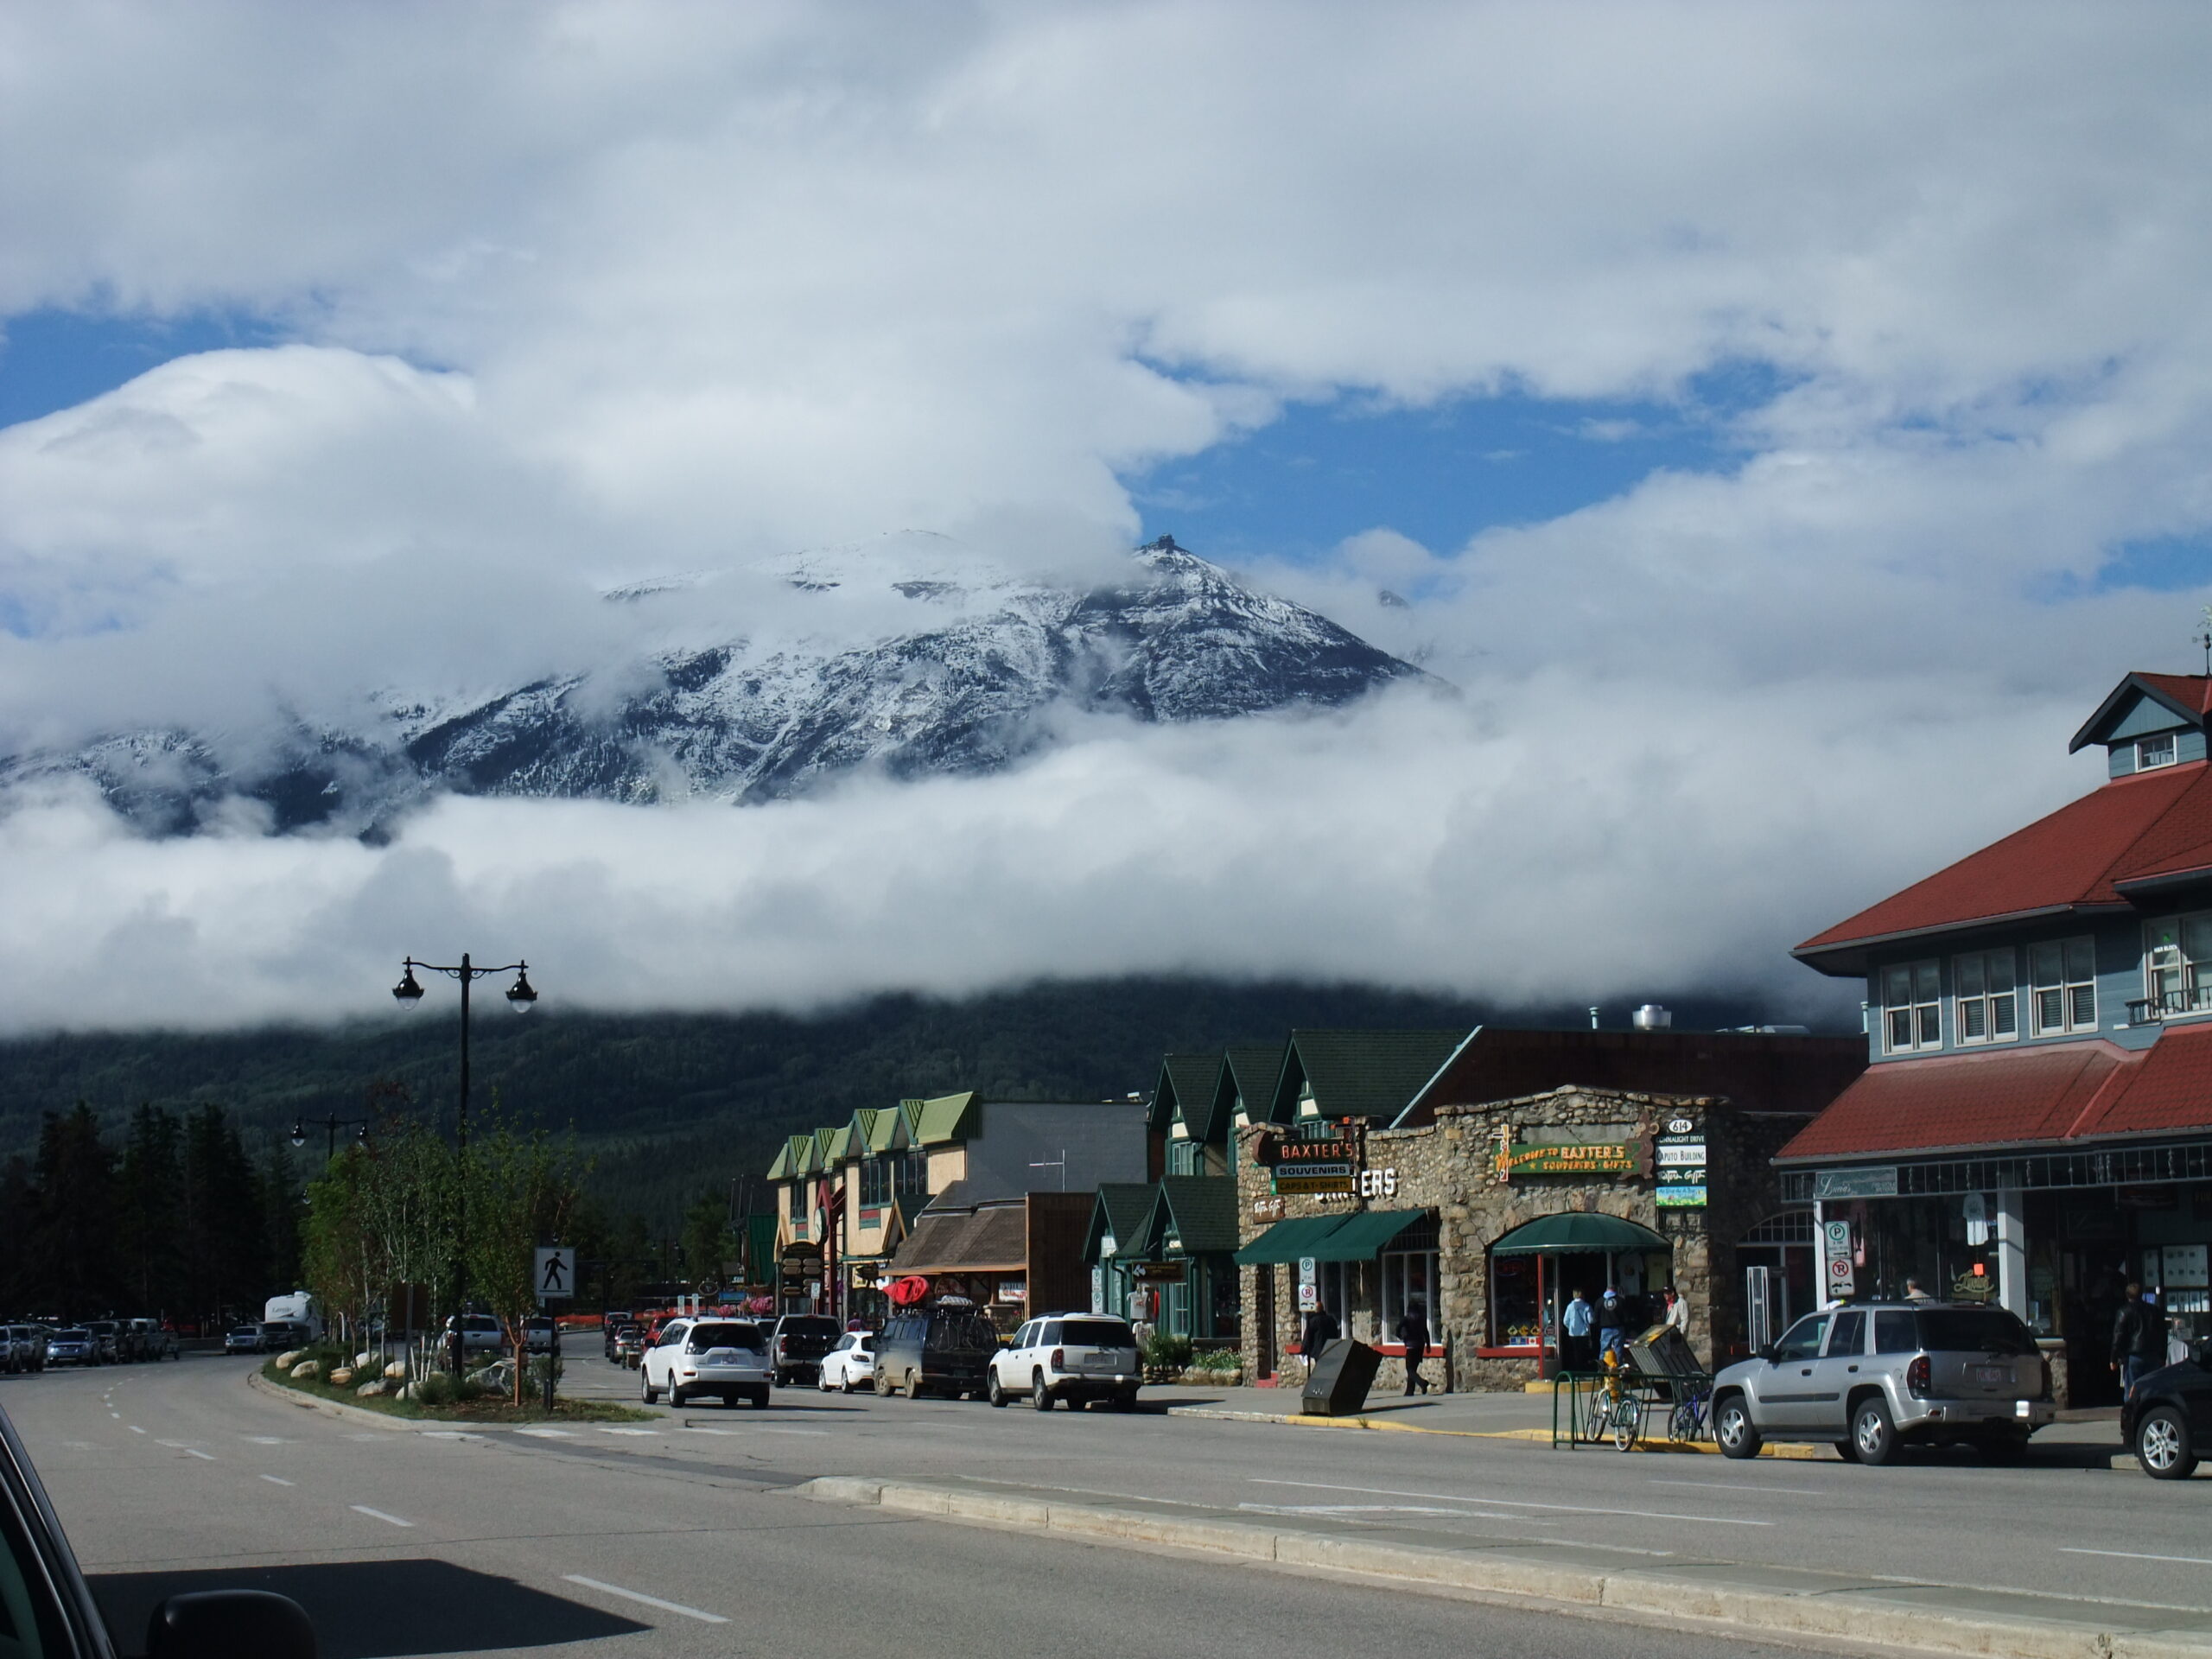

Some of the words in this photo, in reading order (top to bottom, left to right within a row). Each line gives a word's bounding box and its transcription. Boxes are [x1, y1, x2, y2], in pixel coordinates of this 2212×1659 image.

[1673, 1122, 1688, 1131] 614
[1281, 1142, 1354, 1159] BAXTER'S
[1561, 1146, 1624, 1160] BAXTER'S
[1603, 1160, 1633, 1170] GIFTS
[1280, 1166, 1346, 1176] SOUVENIRS
[1279, 1182, 1301, 1191] CAPS
